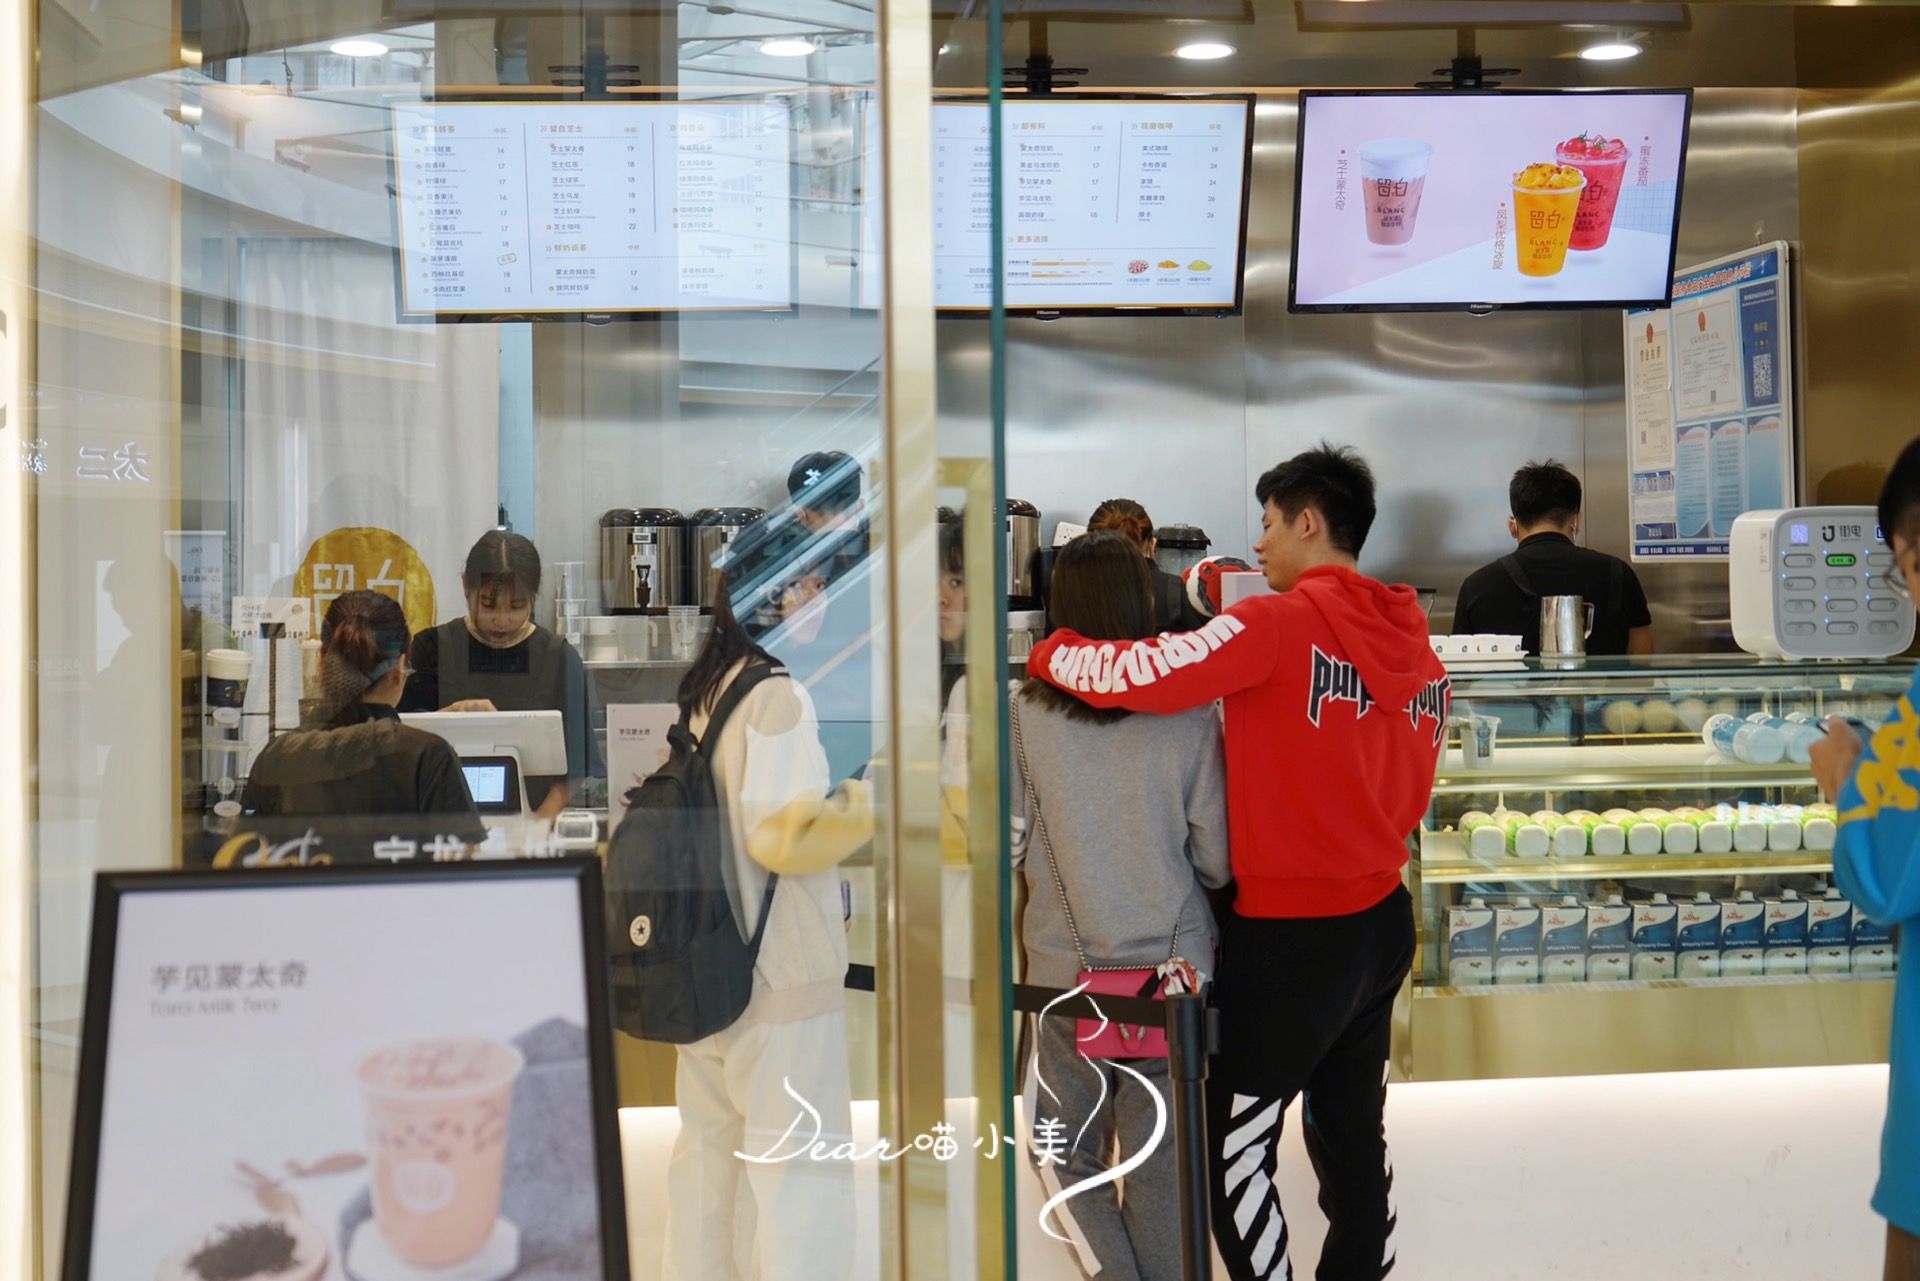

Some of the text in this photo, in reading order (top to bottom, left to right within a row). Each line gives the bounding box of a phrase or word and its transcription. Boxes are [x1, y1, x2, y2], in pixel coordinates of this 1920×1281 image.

[1335, 159, 1348, 211] 芝士蒙太奇
[1376, 177, 1409, 198] 留白
[1529, 209, 1562, 230] 留白
[1017, 235, 1048, 243] 更多选择
[152, 961, 308, 993] 芋见蒙太奇
